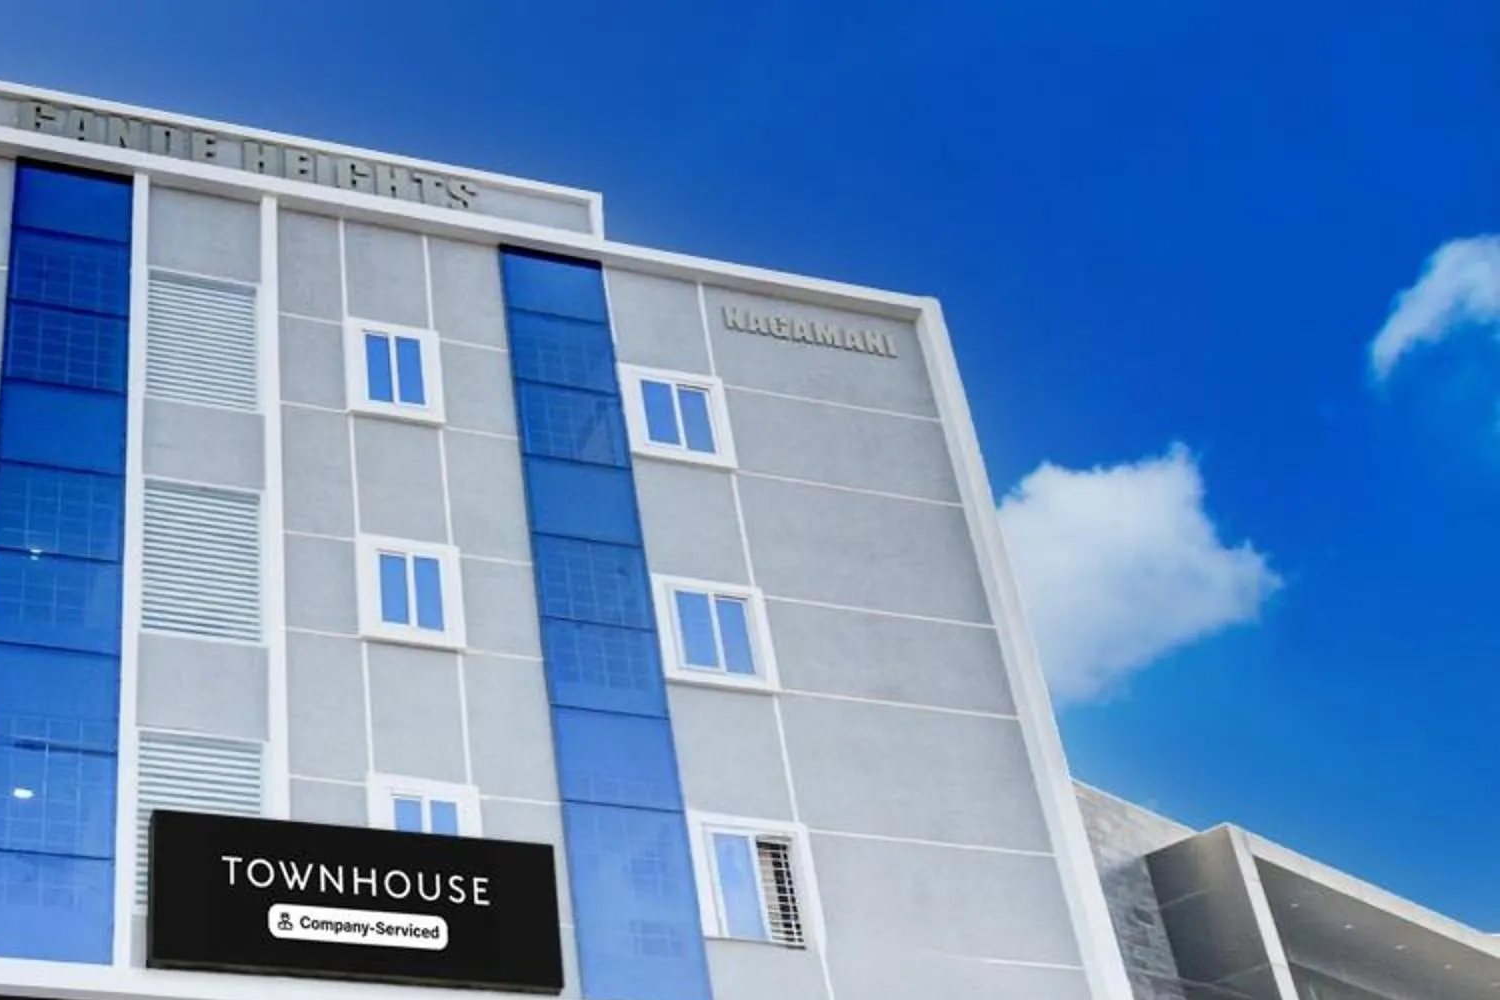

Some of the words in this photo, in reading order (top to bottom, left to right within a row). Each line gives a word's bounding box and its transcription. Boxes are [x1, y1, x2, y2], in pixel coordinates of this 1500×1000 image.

[242, 140, 477, 210] HEIGHTS
[722, 306, 898, 359] NAGAMANI
[221, 855, 491, 906] TOWNHOUSE
[300, 915, 440, 940] Company-Serviced
